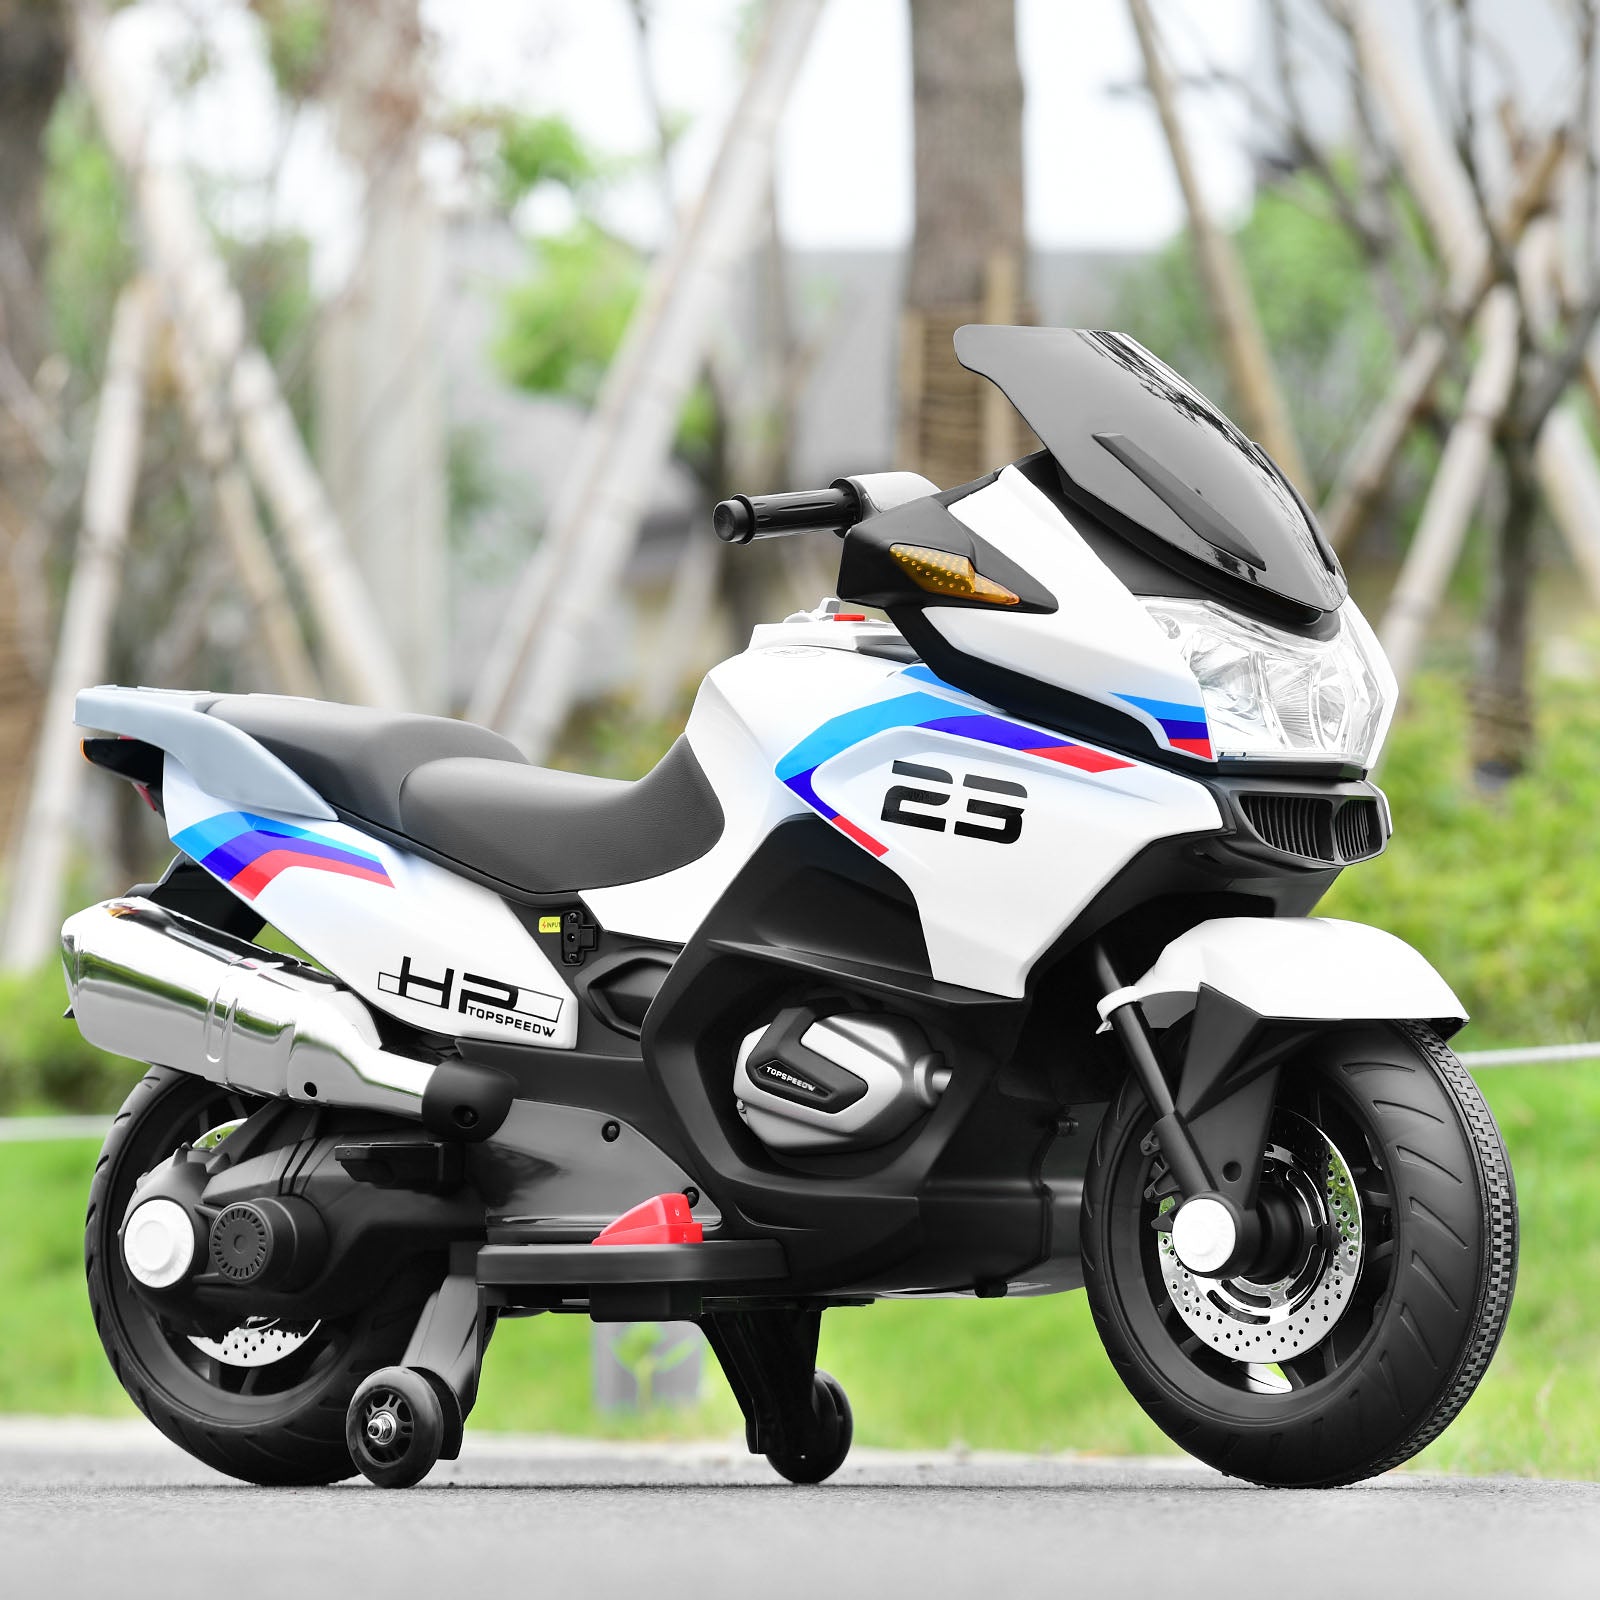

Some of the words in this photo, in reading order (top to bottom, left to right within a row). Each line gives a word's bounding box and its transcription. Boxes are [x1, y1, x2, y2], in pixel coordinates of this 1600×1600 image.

[881, 760, 1028, 844] 23
[399, 956, 518, 1014] HP
[468, 1006, 556, 1037] TOPSPEEDW
[766, 1066, 816, 1092] TOPSPEEDW
